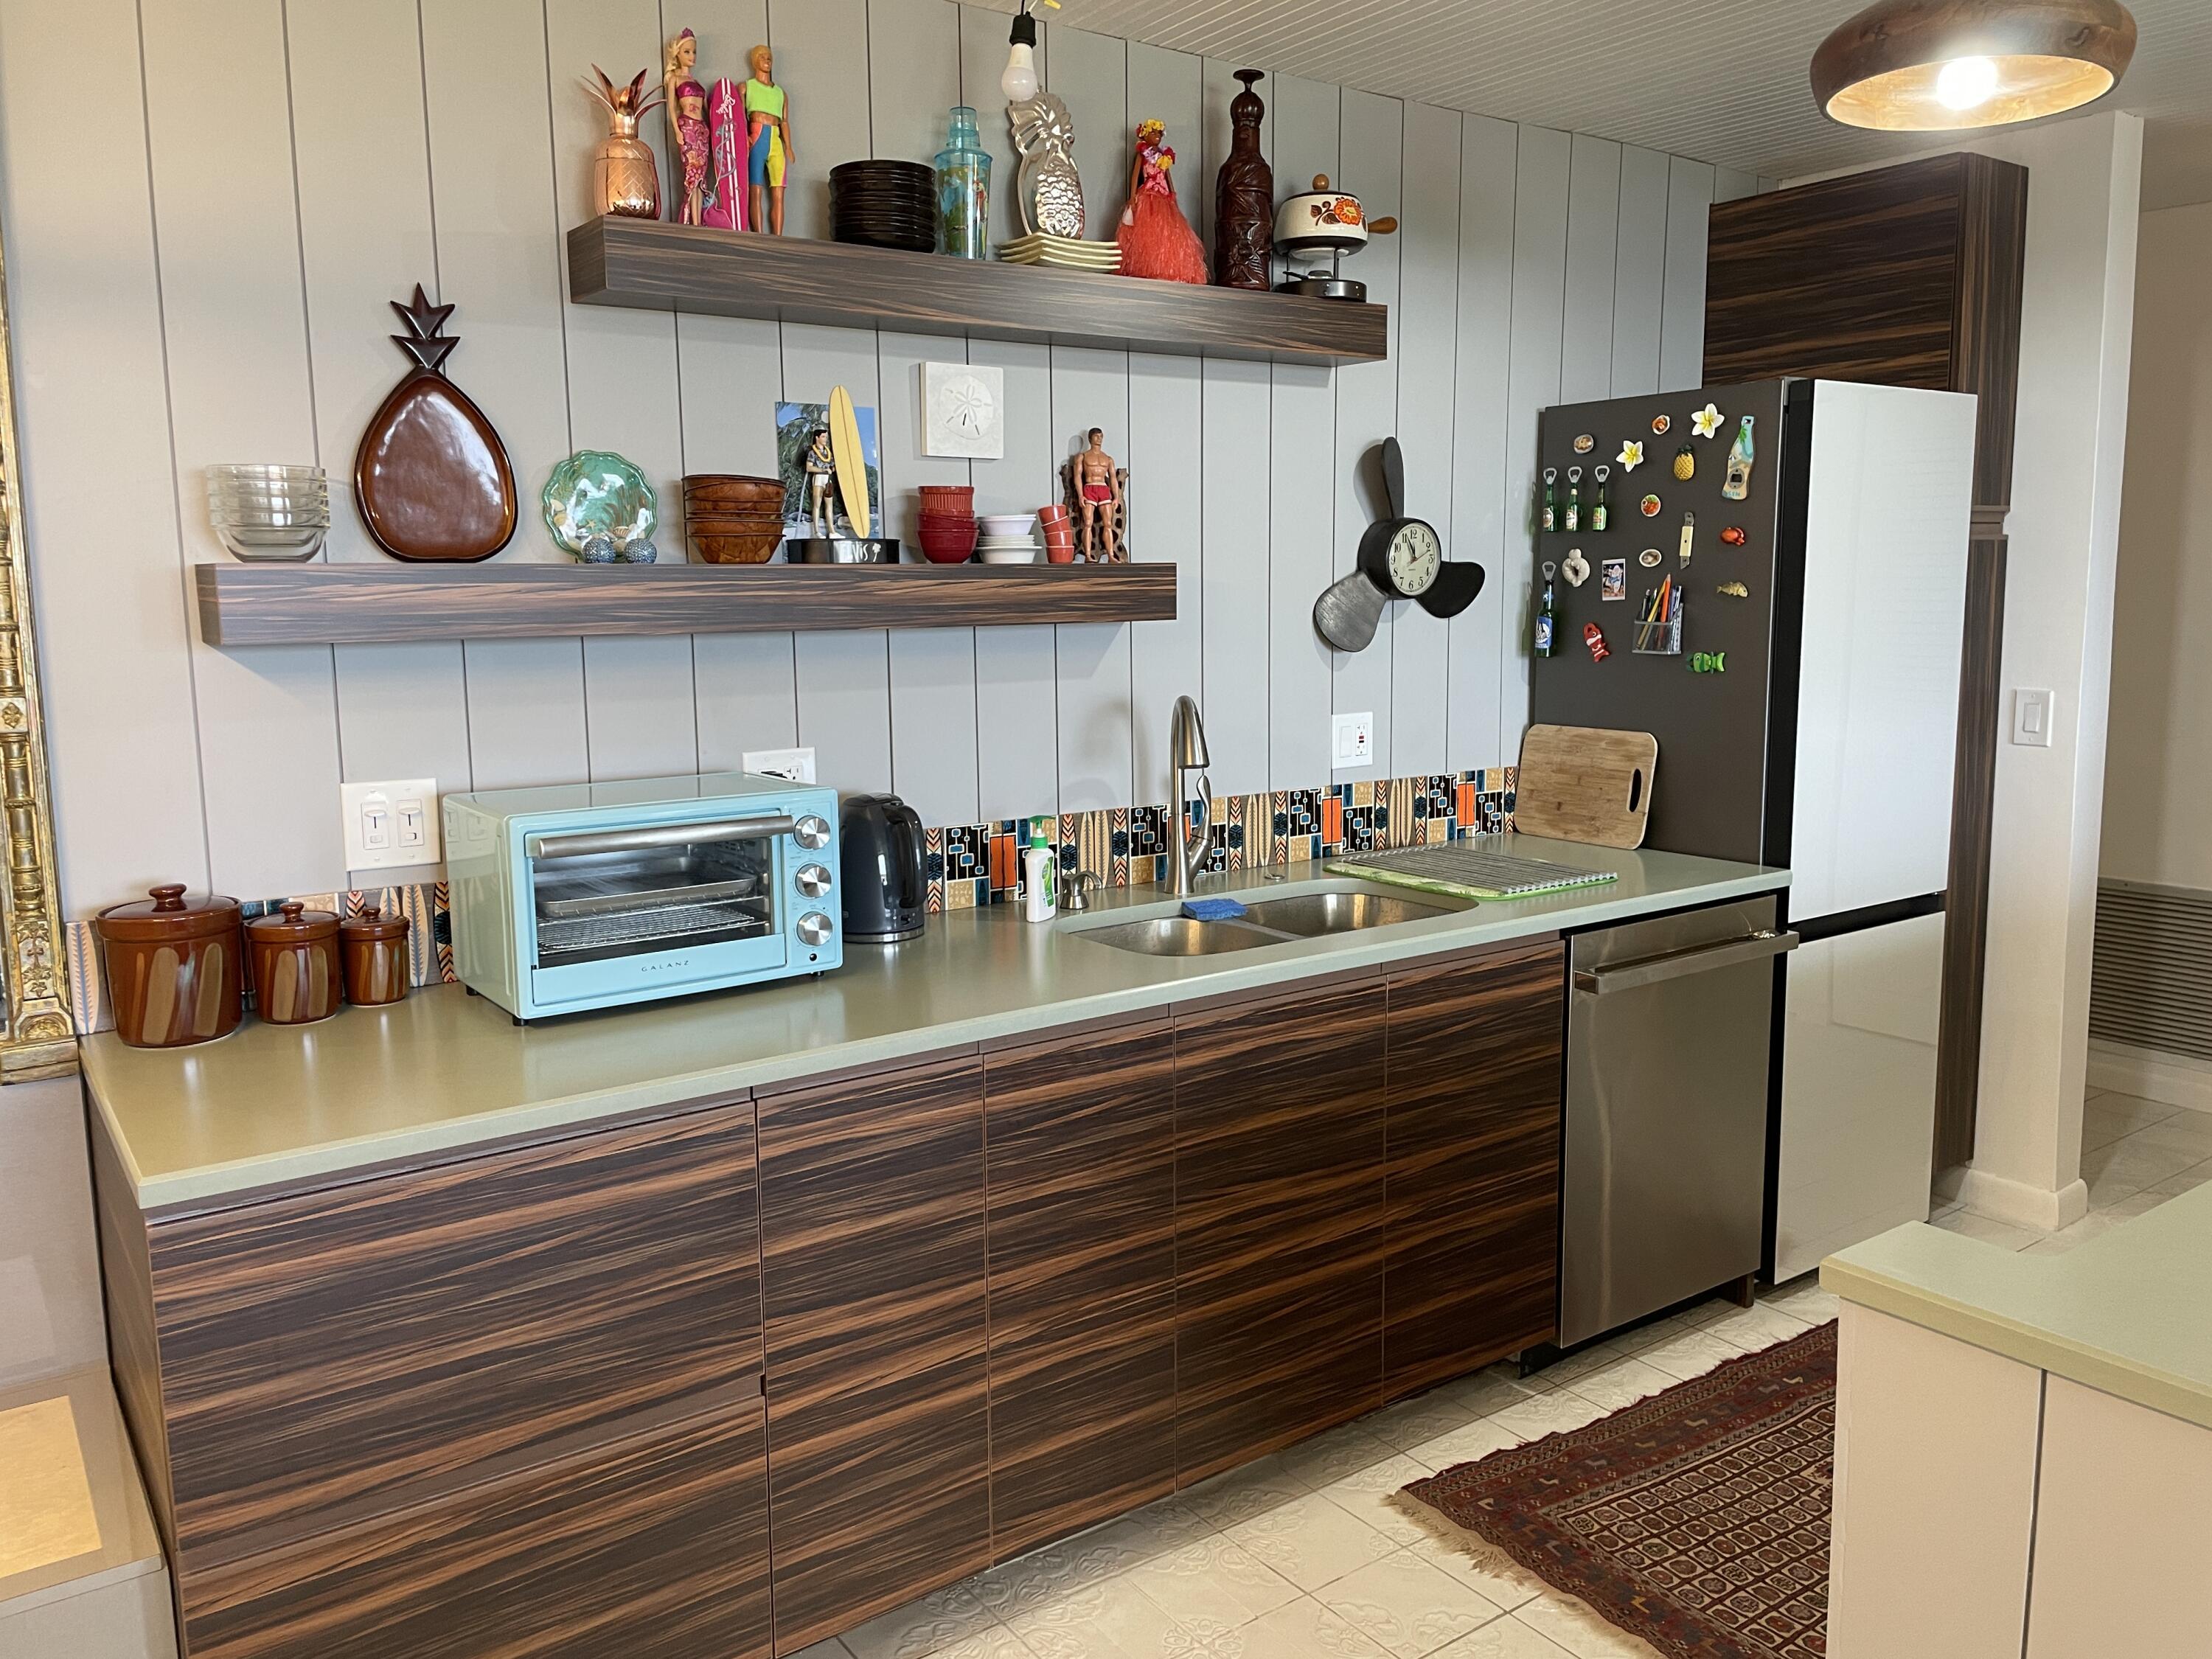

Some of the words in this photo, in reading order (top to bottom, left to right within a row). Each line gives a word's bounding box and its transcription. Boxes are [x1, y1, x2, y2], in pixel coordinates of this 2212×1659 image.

[716, 94, 736, 114] Barbie
[1402, 533, 1408, 543] 11
[1411, 529, 1417, 540] 12
[1394, 543, 1401, 553] 10
[1391, 555, 1396, 565] 9
[1393, 567, 1398, 577] 8
[1425, 566, 1430, 577] 4
[1399, 577, 1405, 586] 7
[1408, 580, 1413, 590] 6
[1418, 577, 1424, 586] 5
[641, 960, 689, 973] GALANZ
